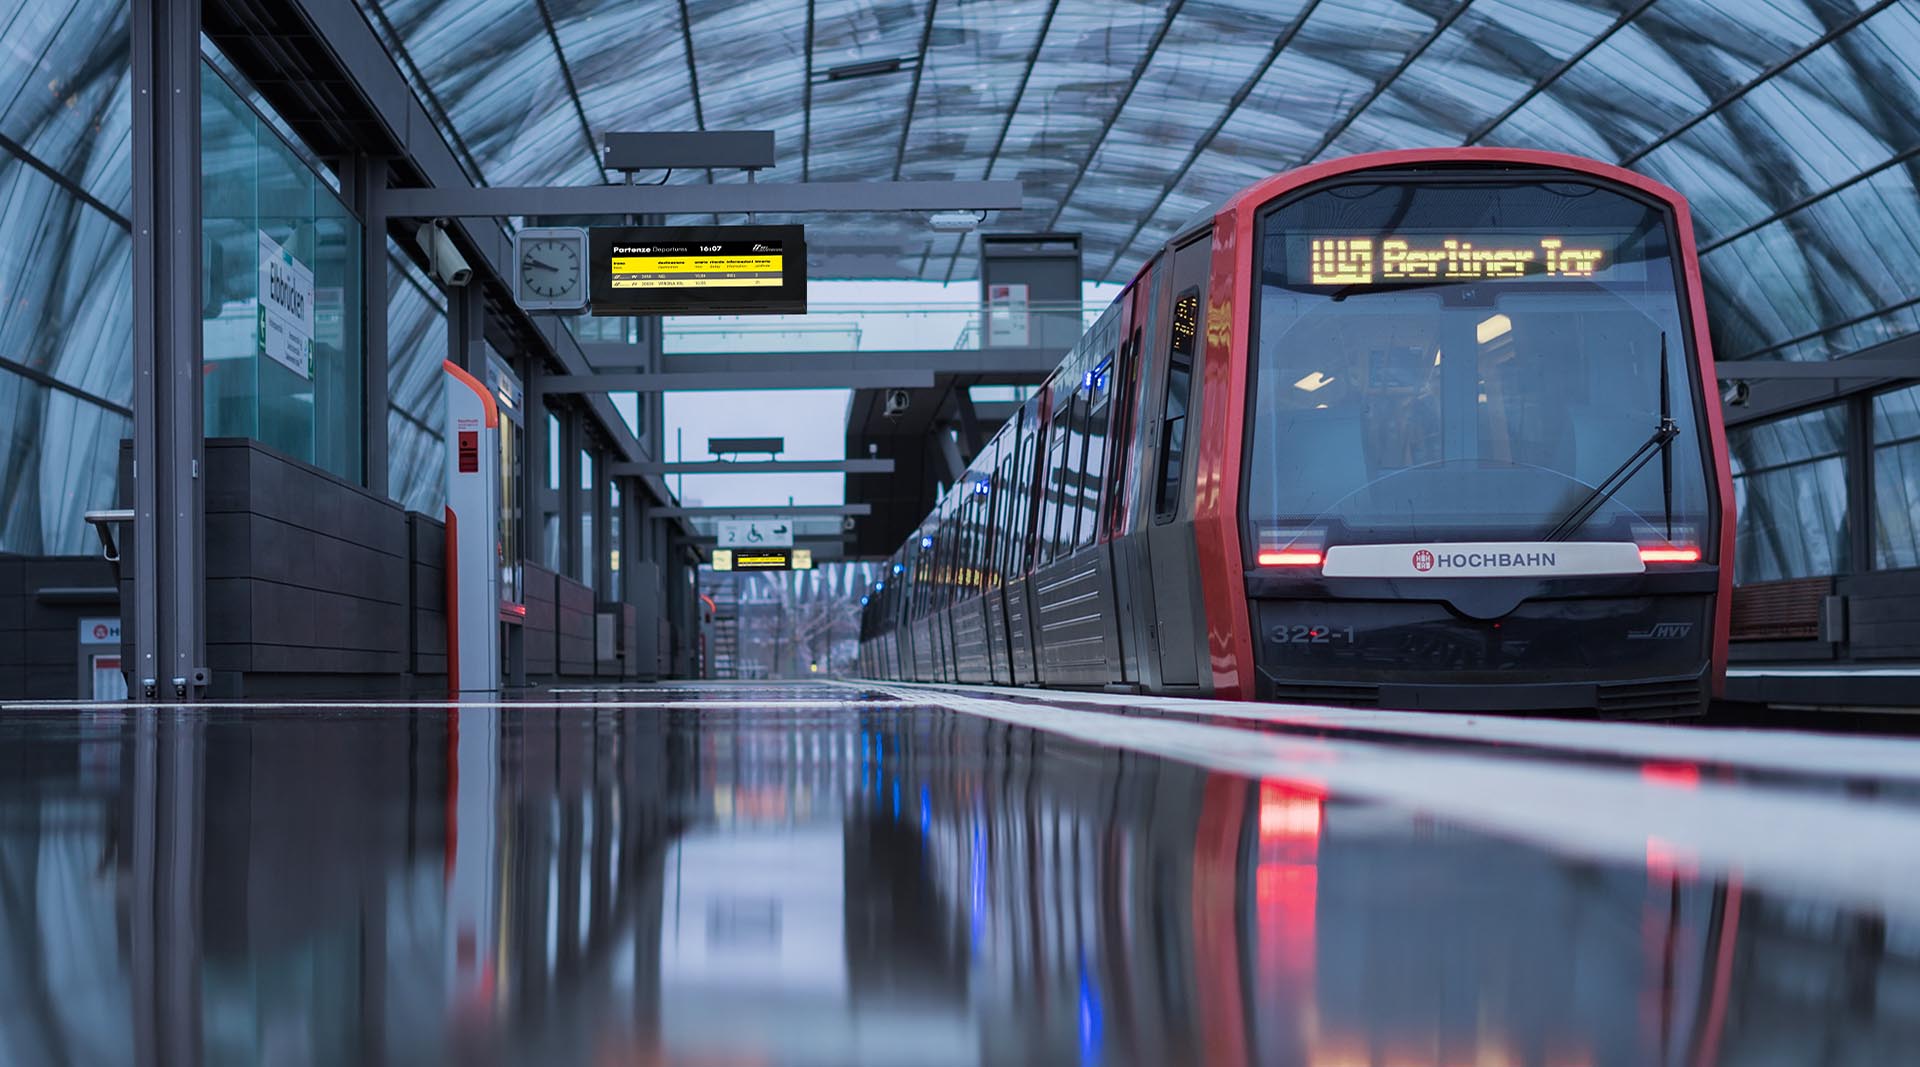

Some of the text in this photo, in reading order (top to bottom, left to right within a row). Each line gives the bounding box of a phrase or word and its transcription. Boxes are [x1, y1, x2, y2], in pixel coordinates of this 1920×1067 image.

[1383, 240, 1535, 278] Berliner
[1541, 239, 1603, 277] Tor
[728, 531, 736, 542] 2
[1437, 552, 1556, 568] HOCHBAHN
[1271, 624, 1355, 644] 322-1
